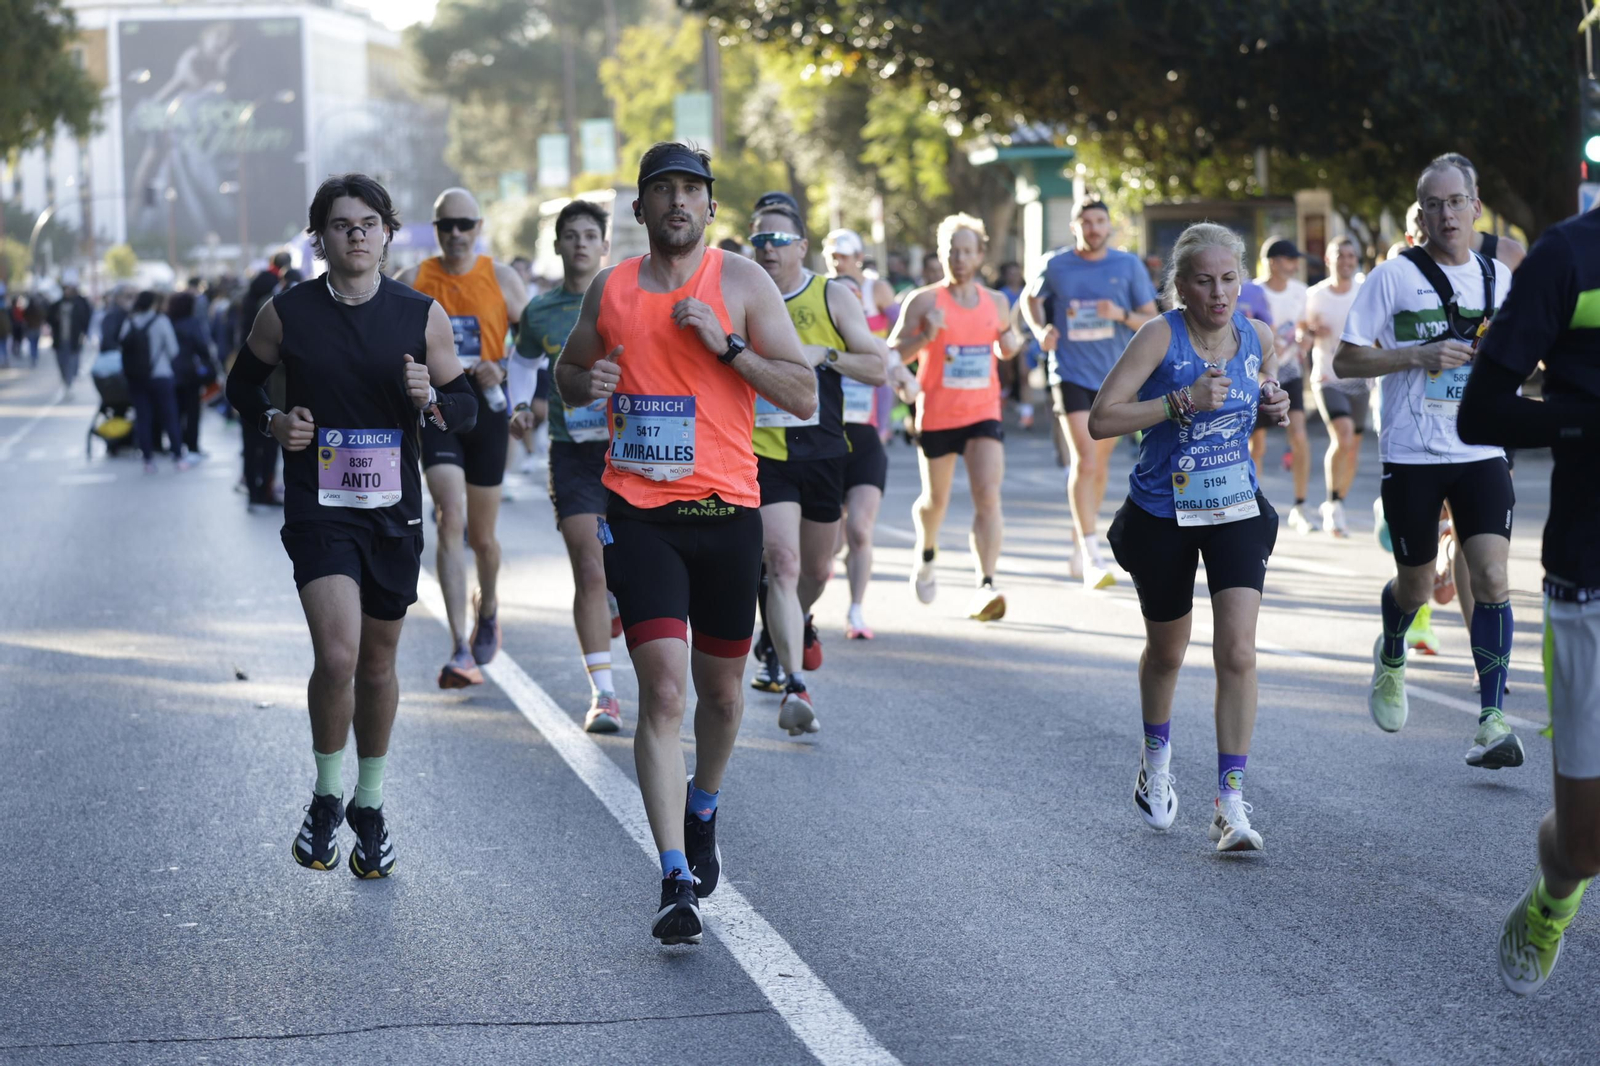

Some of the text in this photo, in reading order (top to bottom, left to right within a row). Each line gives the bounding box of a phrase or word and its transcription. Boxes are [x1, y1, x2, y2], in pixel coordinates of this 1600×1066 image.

[1453, 373, 1468, 382] 583
[1230, 388, 1252, 404] SAN
[634, 400, 684, 412] ZURICH
[636, 425, 660, 437] 5417
[348, 434, 392, 445] ZURICH
[611, 441, 694, 461] I. MIRALLES
[1190, 446, 1211, 455] DOS
[349, 457, 373, 468] 8367
[1201, 450, 1241, 467] ZURICH
[341, 472, 381, 488] ANTO
[1203, 476, 1227, 488] 5194
[1175, 489, 1254, 509] CRGJ OS QUIERO
[677, 506, 736, 516] HANKER
